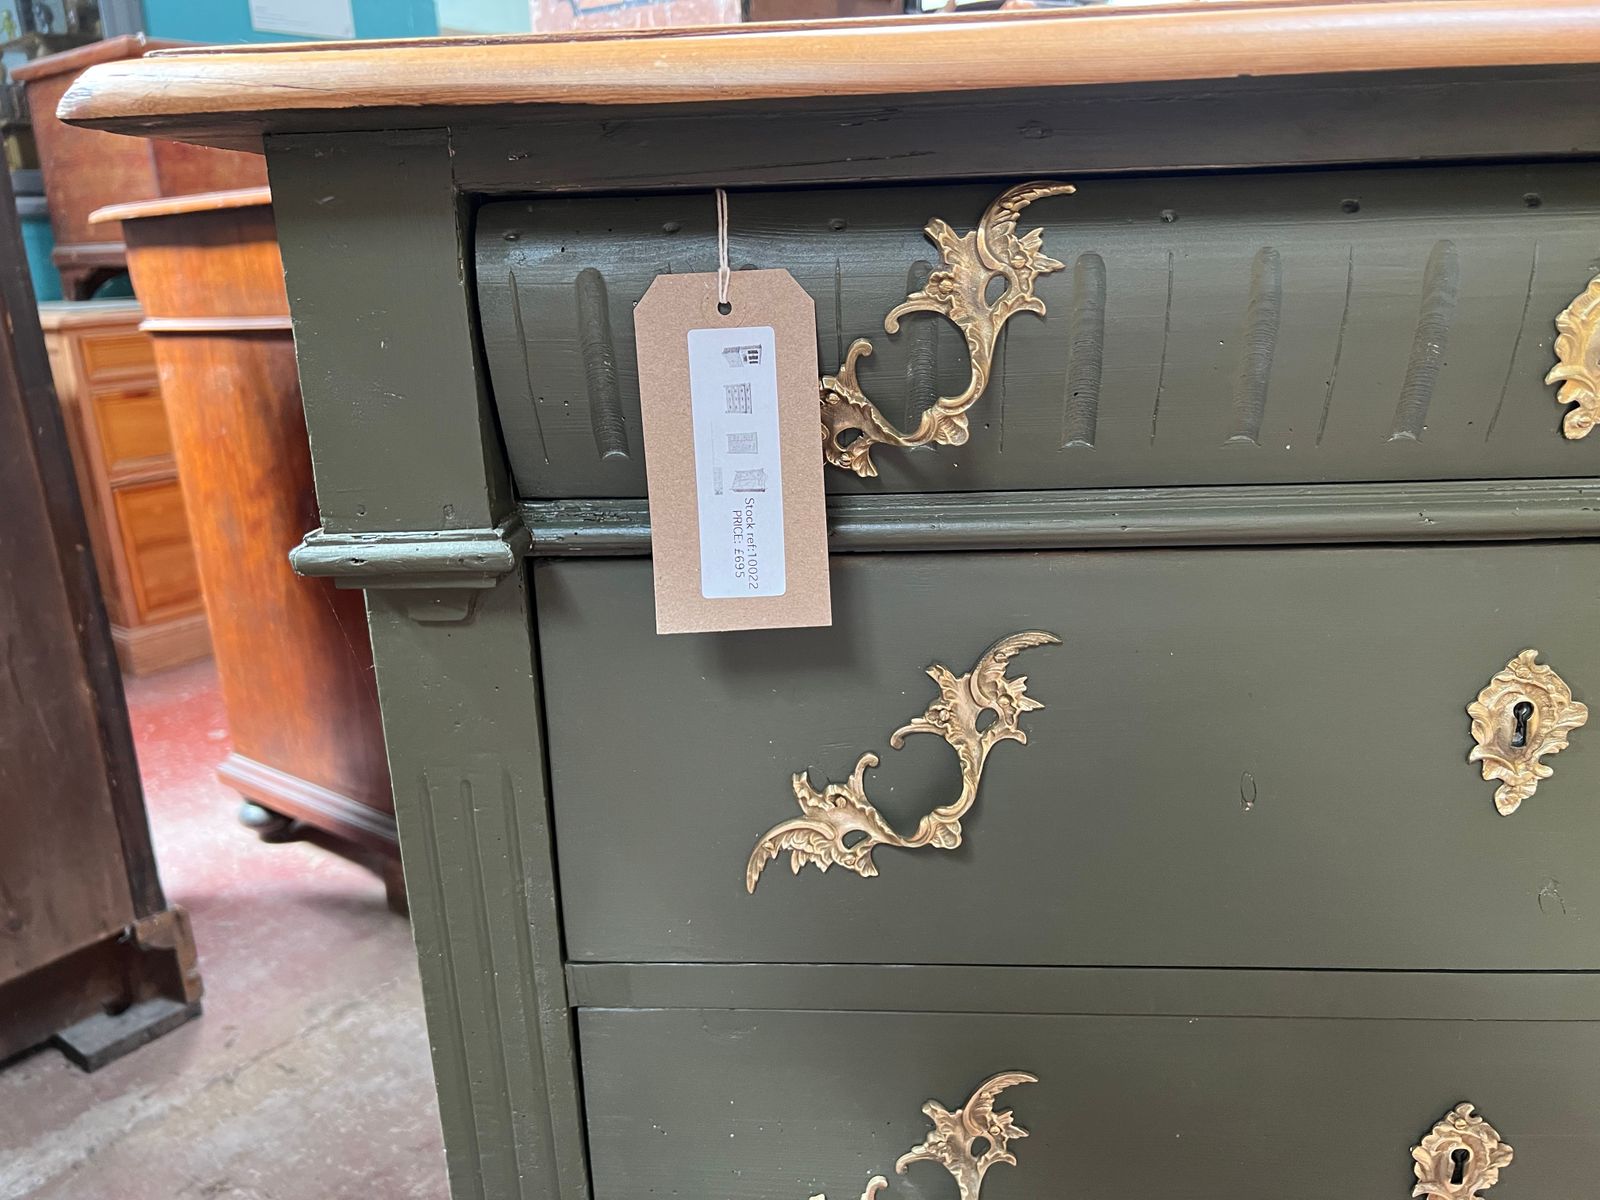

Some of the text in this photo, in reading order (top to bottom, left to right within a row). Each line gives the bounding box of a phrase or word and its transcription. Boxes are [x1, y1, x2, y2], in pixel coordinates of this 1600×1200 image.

[732, 510, 746, 578] PRICE: £695
[744, 497, 759, 590] Stock ref:10022
